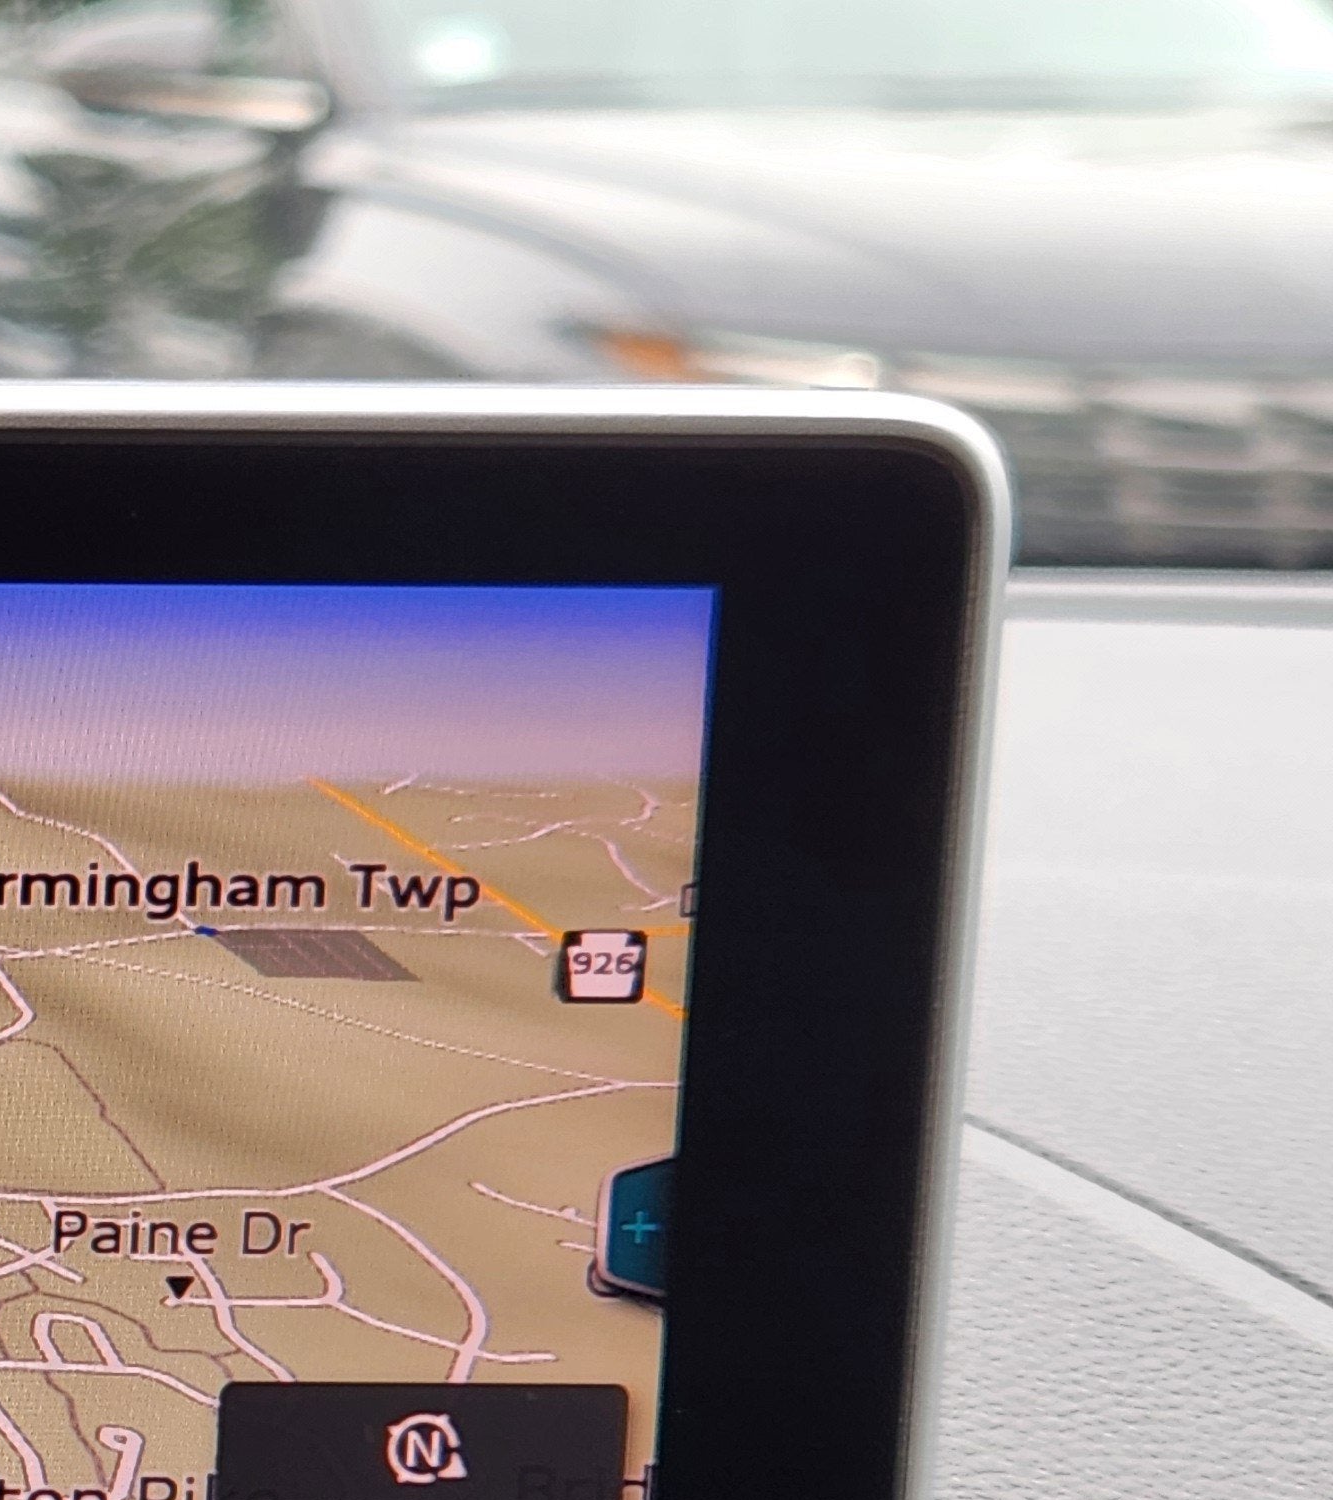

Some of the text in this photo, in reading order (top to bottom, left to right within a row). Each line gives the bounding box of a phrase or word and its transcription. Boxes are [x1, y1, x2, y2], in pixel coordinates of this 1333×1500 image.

[350, 864, 481, 919] Twp
[571, 951, 636, 976] 926
[53, 1211, 311, 1255] Paine Dr
